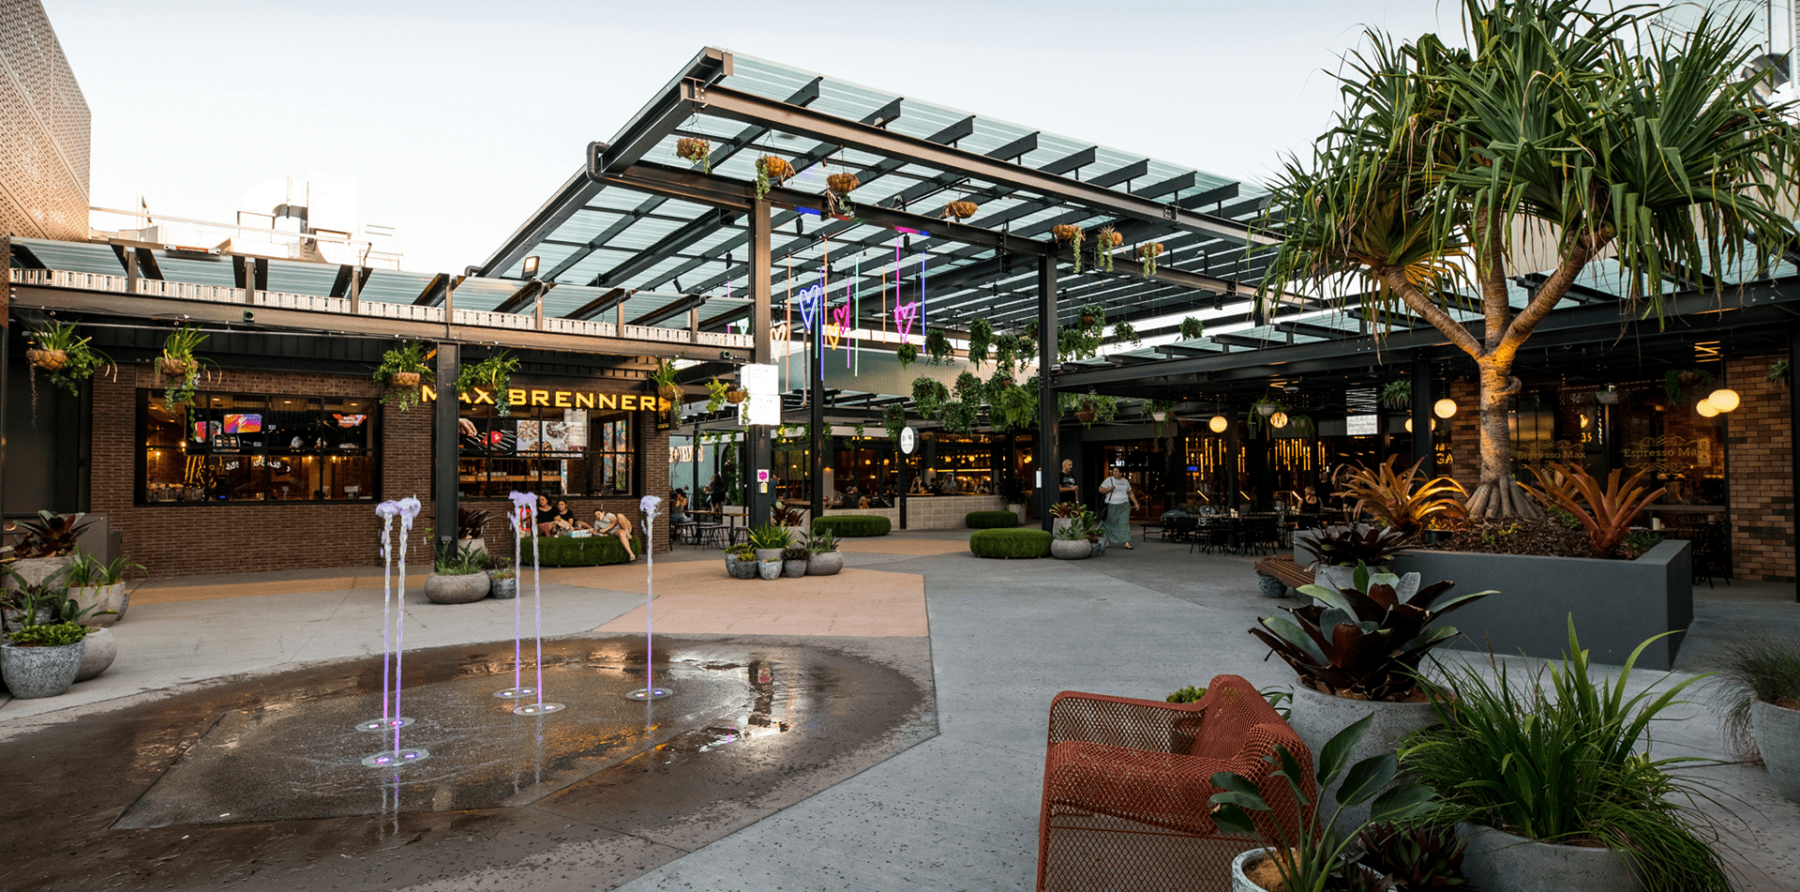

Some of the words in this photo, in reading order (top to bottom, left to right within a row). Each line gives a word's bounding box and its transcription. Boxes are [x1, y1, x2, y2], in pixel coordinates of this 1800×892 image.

[421, 384, 495, 405] MAX
[508, 388, 657, 412] BRENNER
[1515, 450, 1561, 461] Espresso
[1563, 450, 1586, 459] Max
[1623, 448, 1675, 459] Espresso
